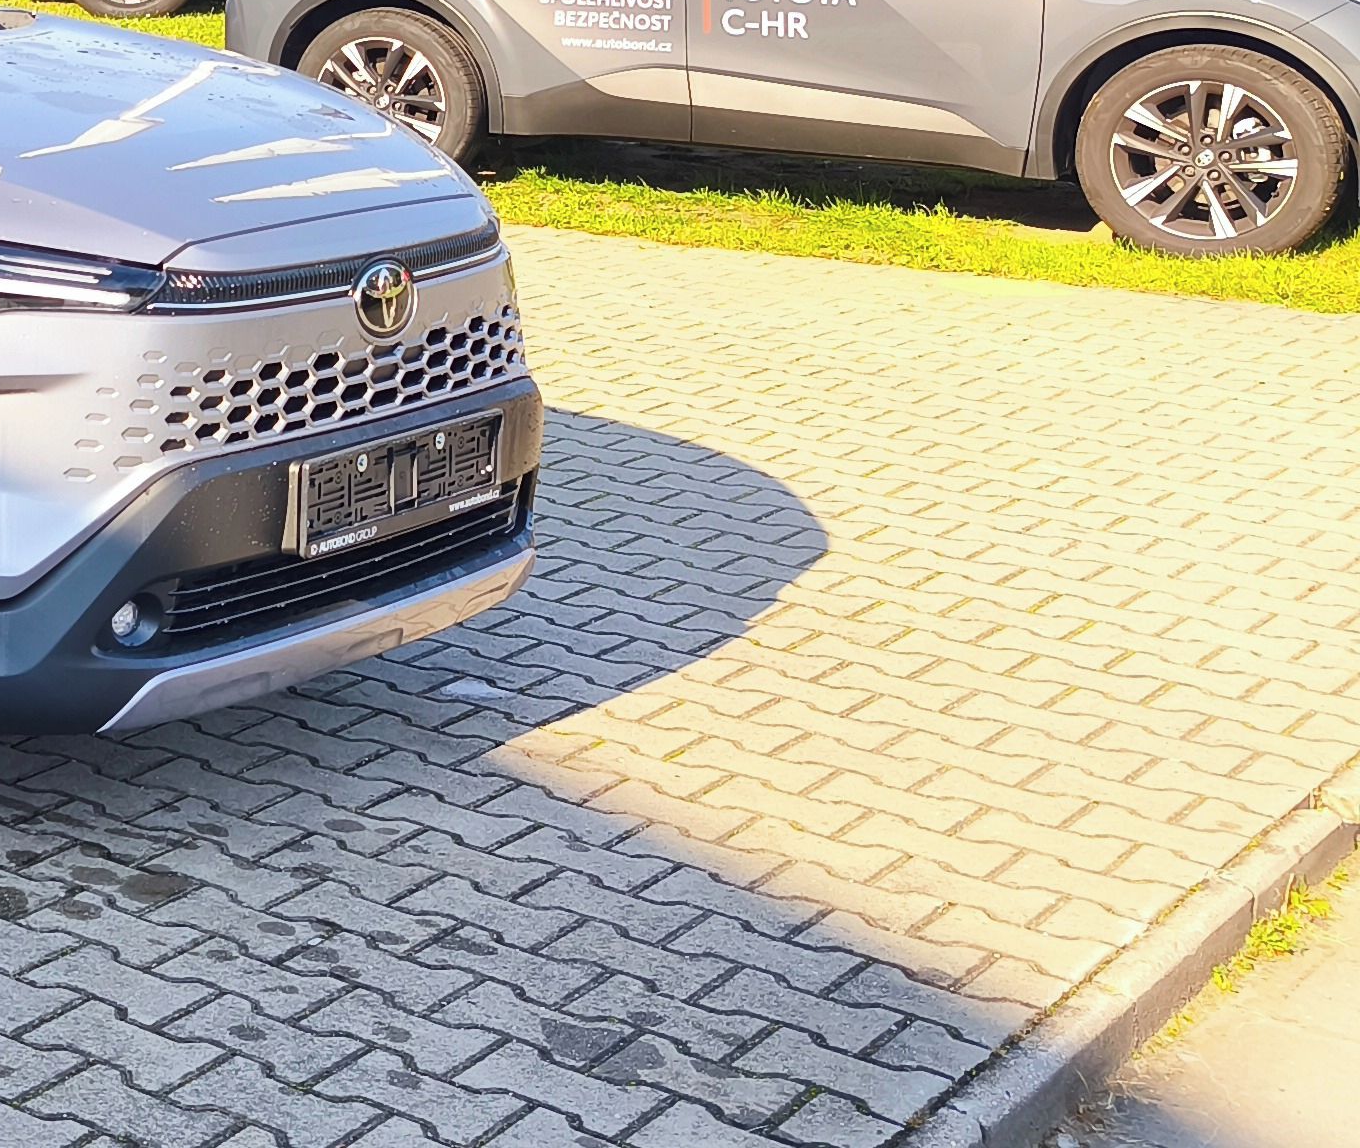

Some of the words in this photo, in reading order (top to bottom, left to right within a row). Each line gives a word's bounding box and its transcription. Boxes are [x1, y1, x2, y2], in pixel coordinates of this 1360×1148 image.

[553, 8, 672, 32] BEZPEČNOST
[720, 8, 809, 39] C-HR
[561, 35, 672, 52] www.autobond.cz
[318, 532, 356, 554] AUTOBOND
